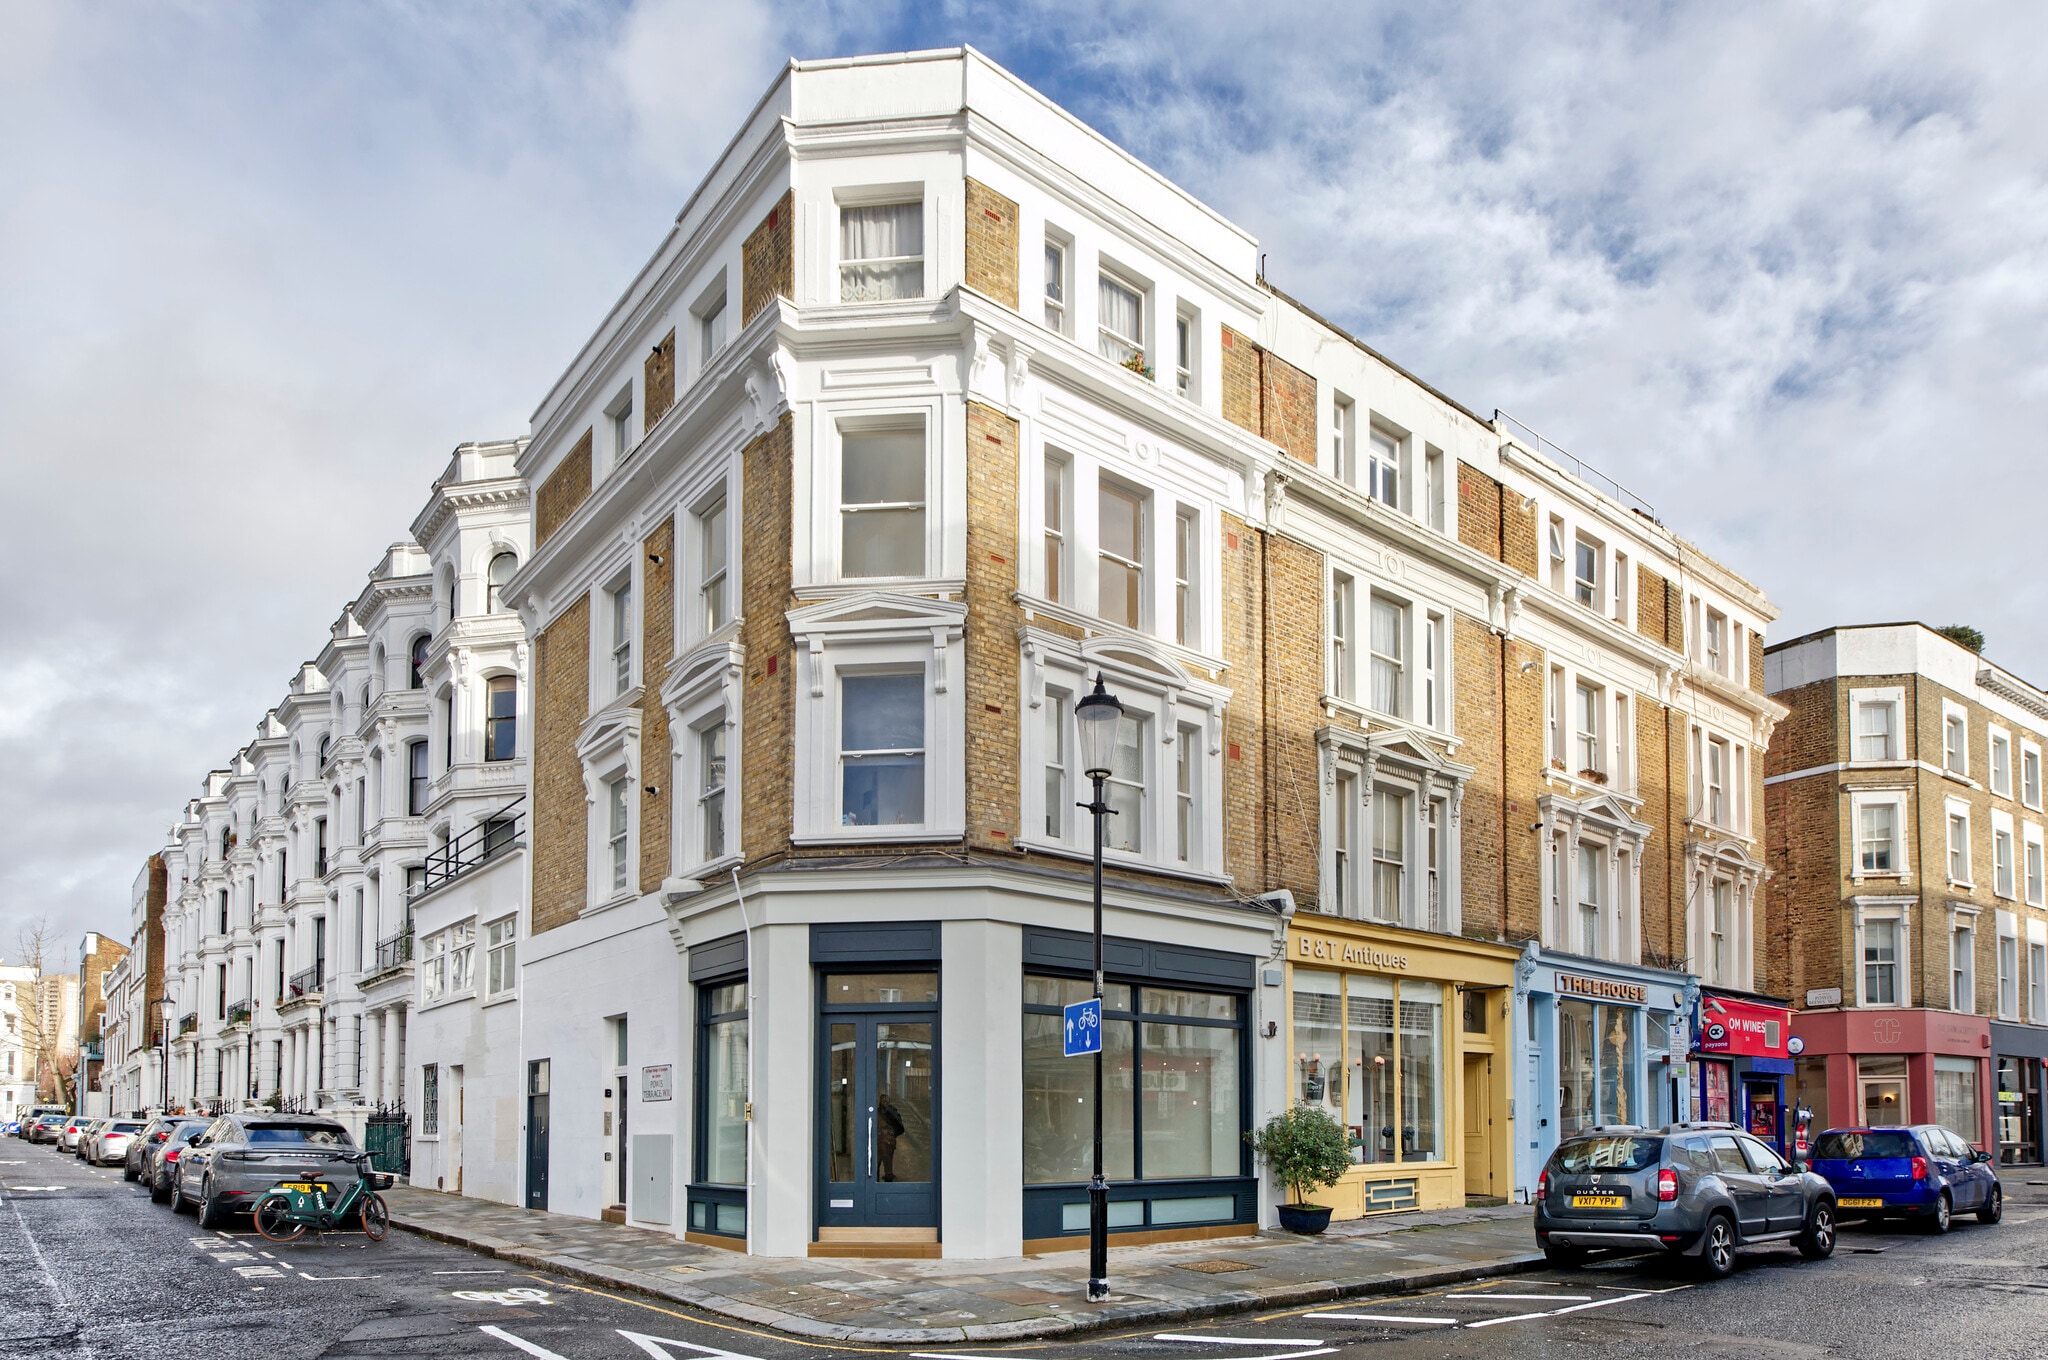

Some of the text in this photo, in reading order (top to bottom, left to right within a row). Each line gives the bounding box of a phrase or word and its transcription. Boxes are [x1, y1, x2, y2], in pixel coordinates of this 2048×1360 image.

[1343, 942, 1408, 970] Antiques
[1561, 976, 1647, 1001] TREEHOUSE
[1728, 1018, 1766, 1034] OM WINES
[316, 1191, 325, 1210] forest
[1578, 1197, 1597, 1206] VX17
